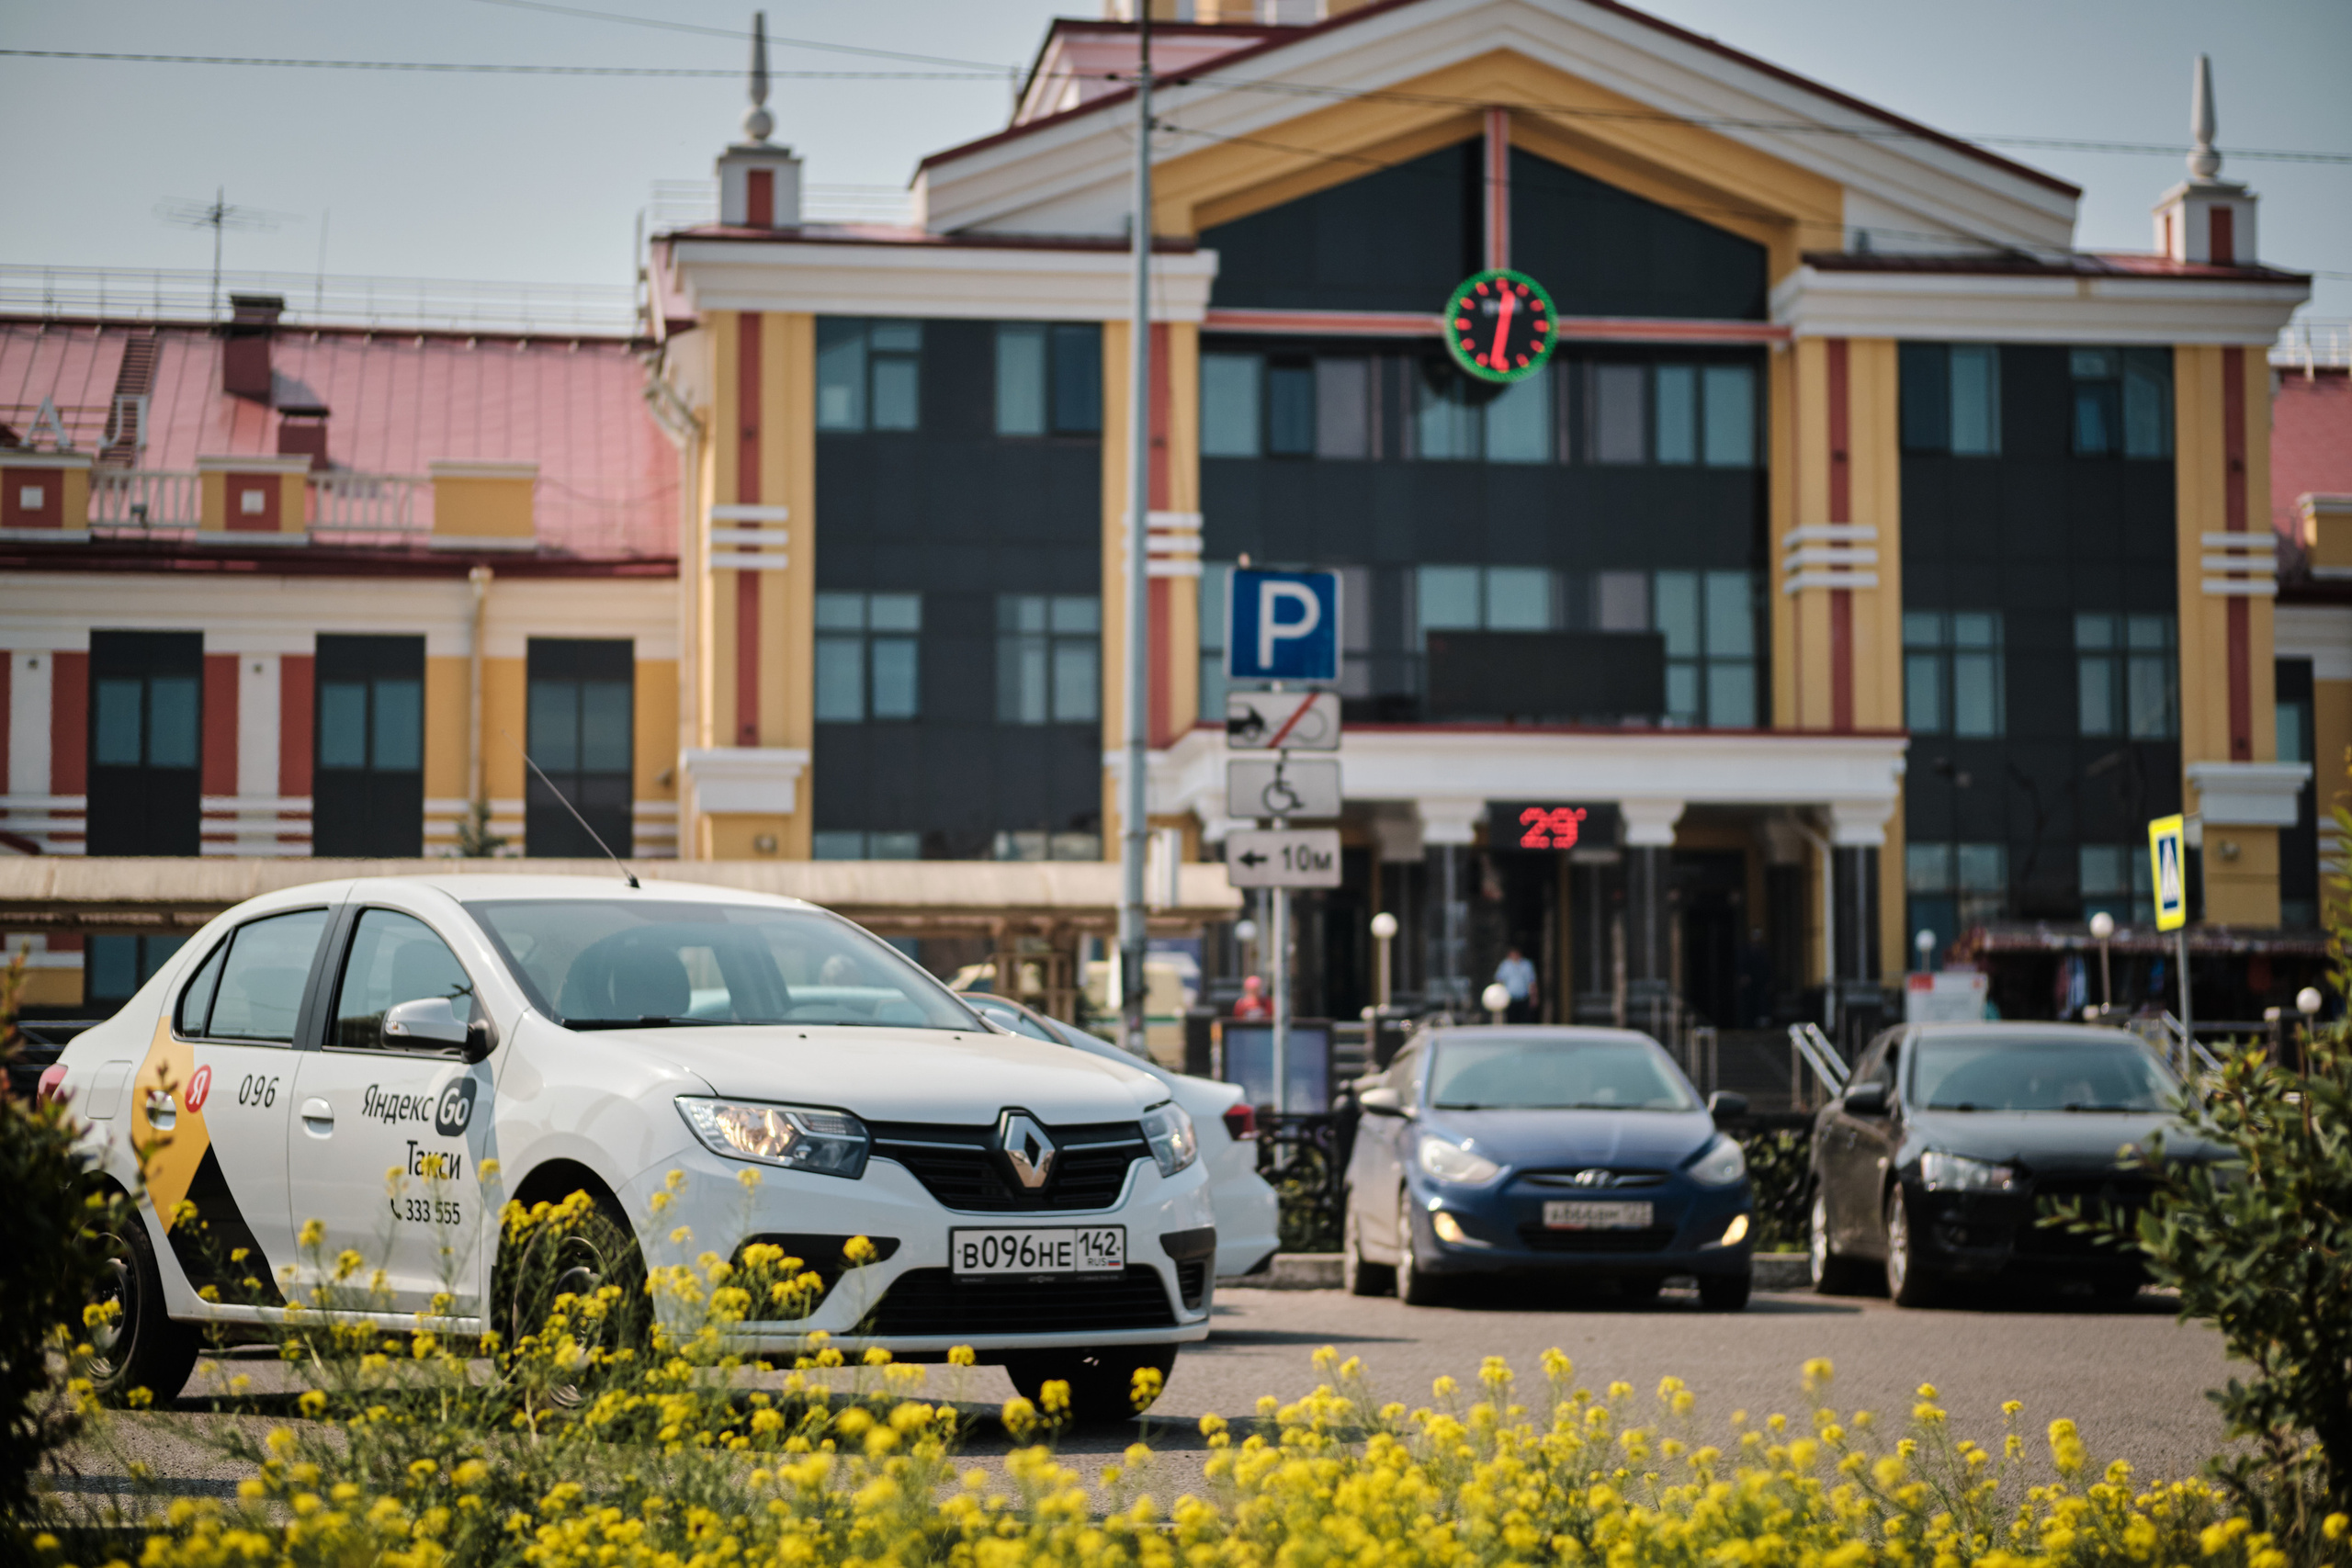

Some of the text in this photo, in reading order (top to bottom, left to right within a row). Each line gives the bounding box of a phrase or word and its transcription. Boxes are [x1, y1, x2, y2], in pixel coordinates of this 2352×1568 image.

[1258, 581, 1321, 671] P
[1281, 845, 1332, 871] 10м
[188, 1070, 208, 1105] Я
[239, 1074, 279, 1108] 096
[362, 1084, 469, 1126] Яндекс Go
[406, 1199, 460, 1225] 333 555
[964, 1231, 1117, 1269] В096НЕ 142
[1087, 1257, 1107, 1267] RUS
